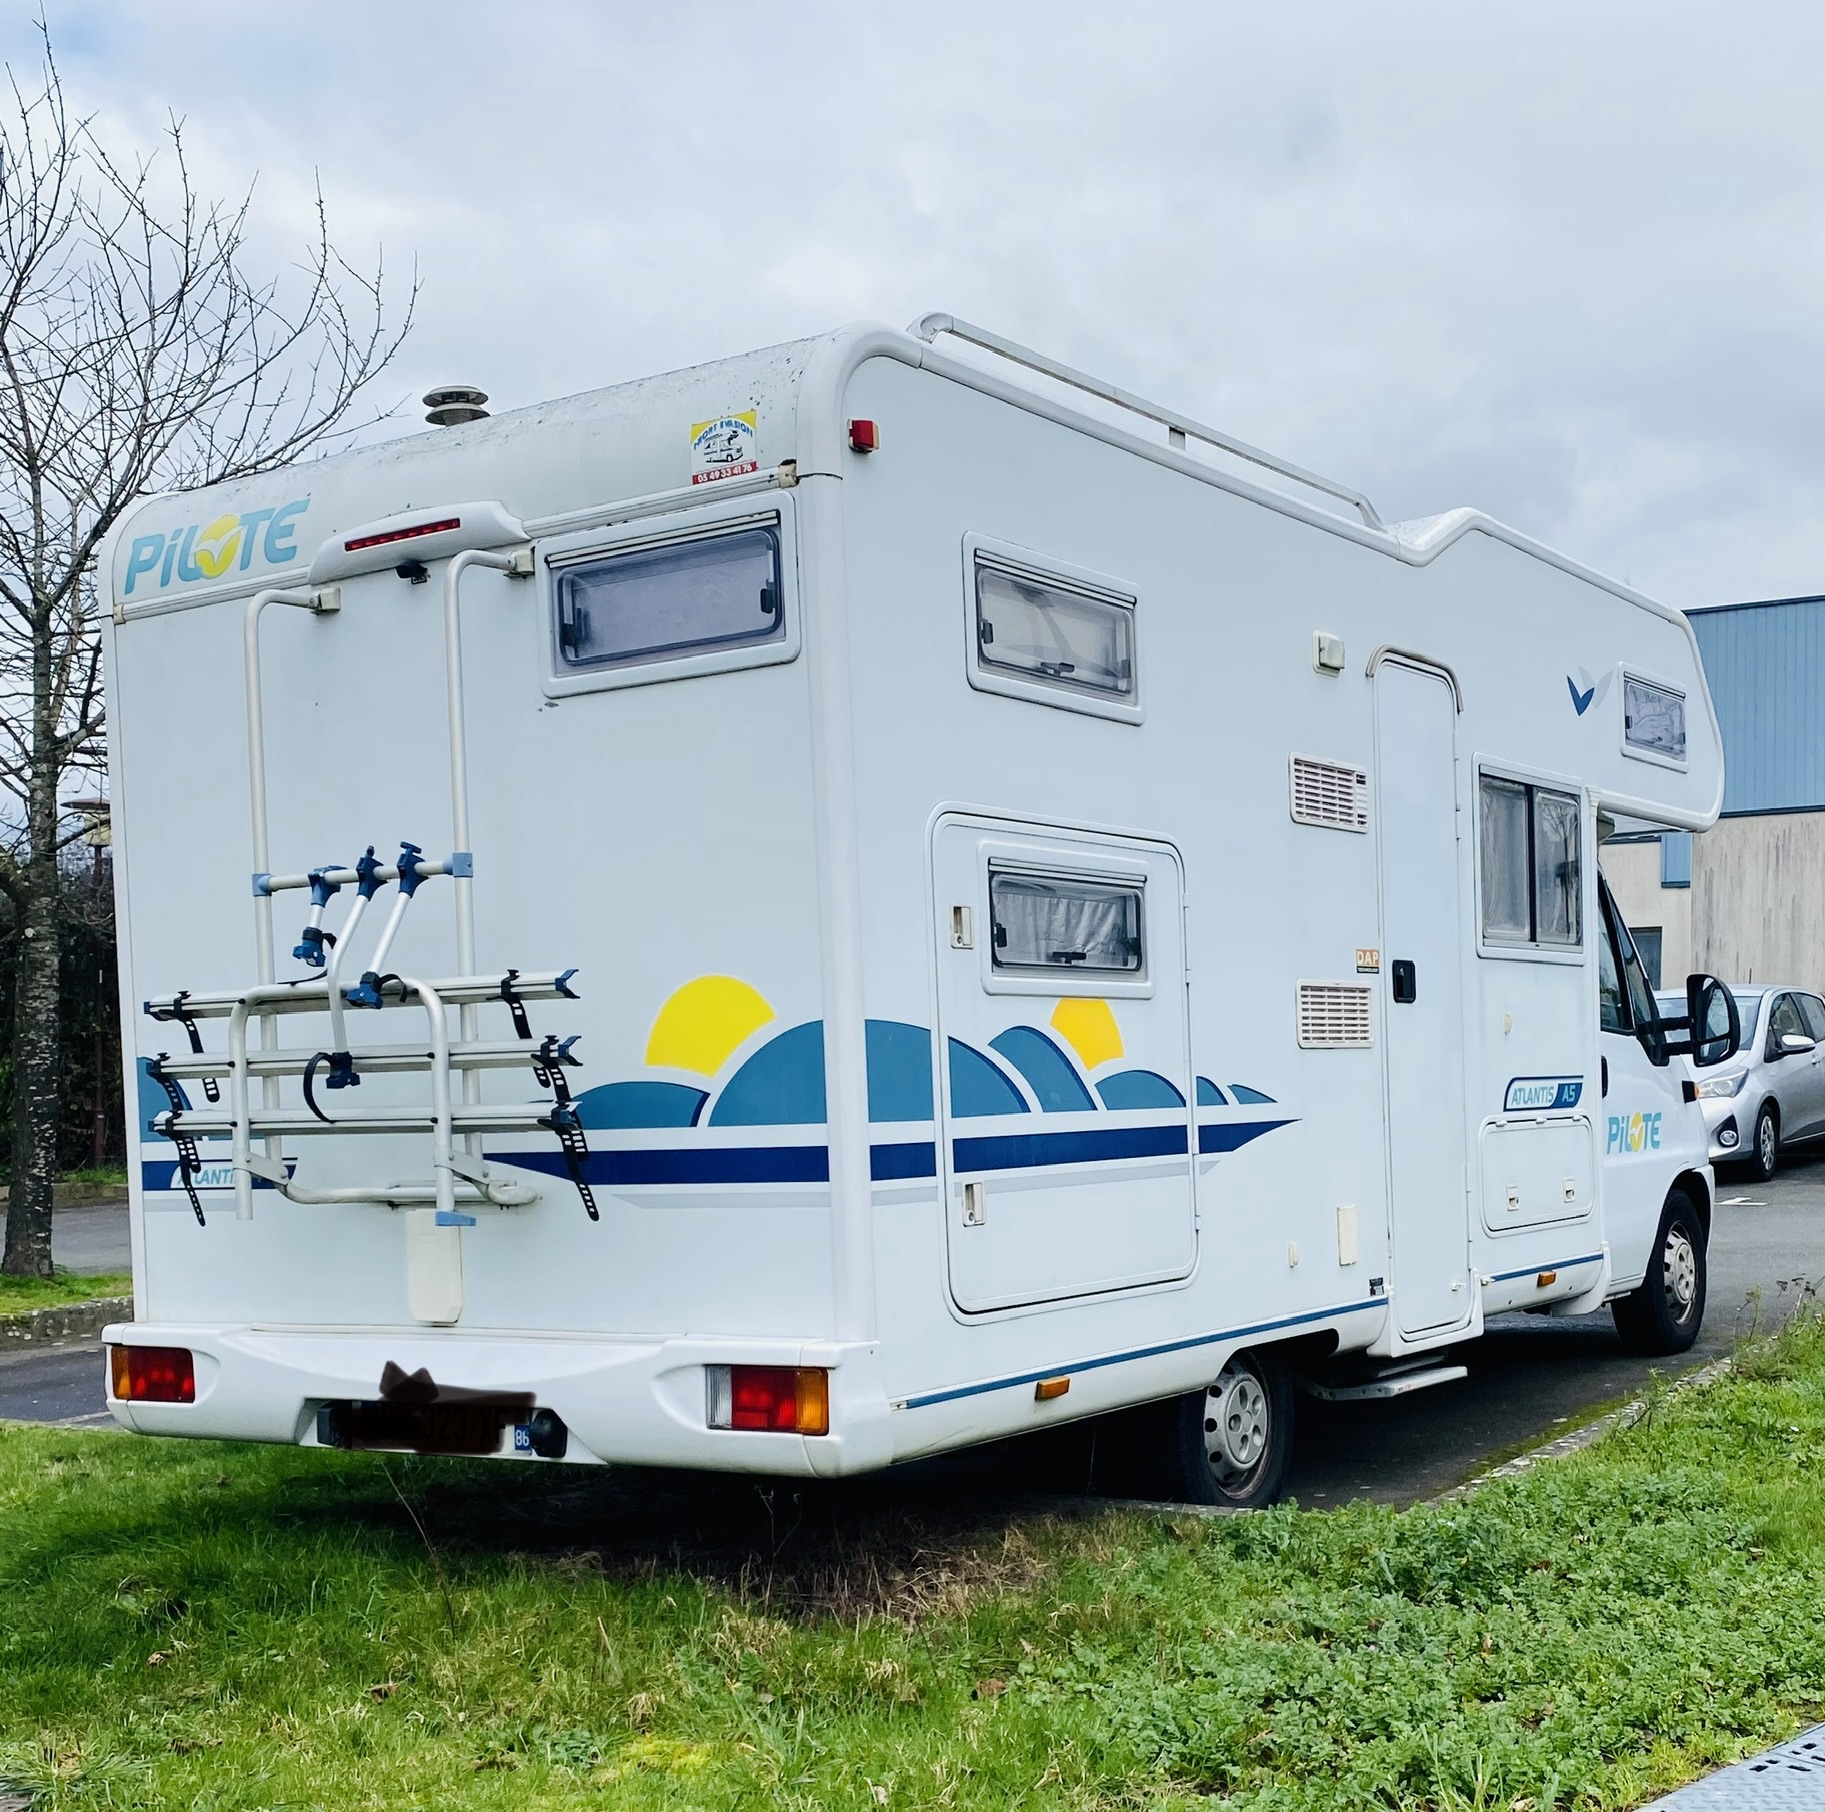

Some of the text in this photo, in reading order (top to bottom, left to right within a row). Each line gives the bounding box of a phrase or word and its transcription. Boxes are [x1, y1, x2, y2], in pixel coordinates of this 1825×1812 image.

[720, 420, 753, 438] EVASION
[697, 464, 753, 483] 05 49 33 41 76
[1357, 951, 1379, 966] DAP
[515, 1430, 530, 1446] 86
